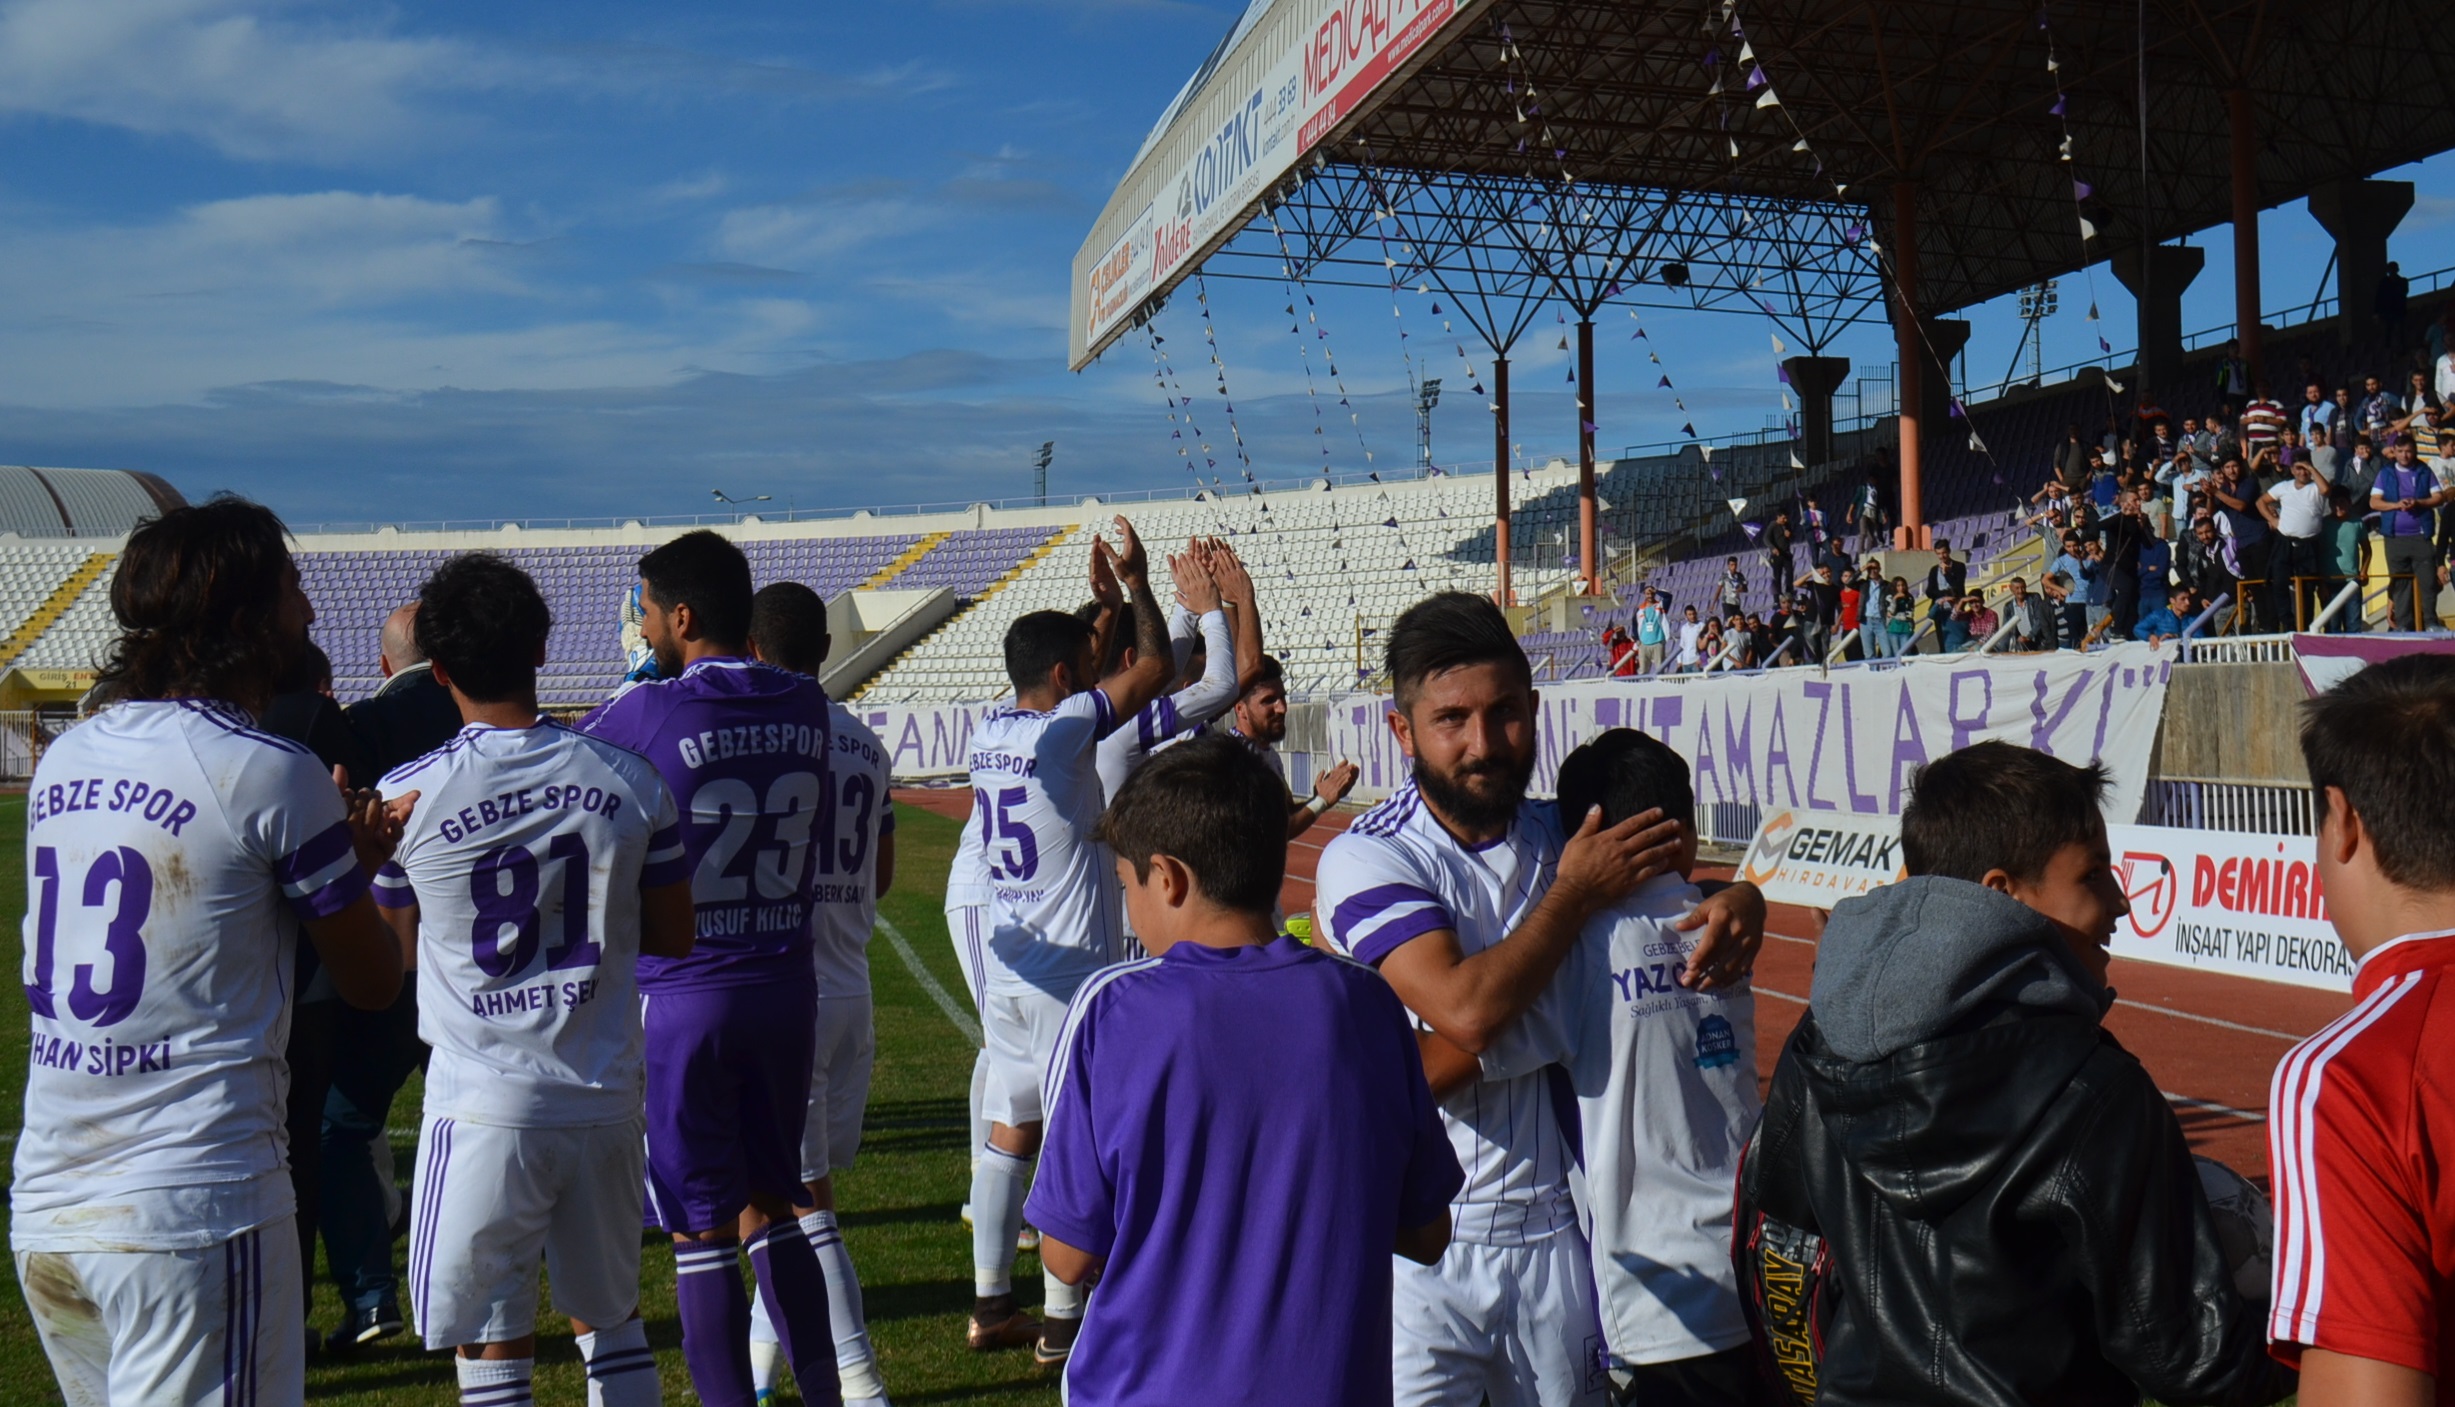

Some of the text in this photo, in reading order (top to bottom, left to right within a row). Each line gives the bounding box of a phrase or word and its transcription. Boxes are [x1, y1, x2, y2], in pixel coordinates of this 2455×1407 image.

[1302, 0, 1419, 109] MEDICAL
[1263, 74, 1297, 128] 444 33 69
[39, 671, 96, 682] GİRİŞ ENT
[65, 680, 77, 689] 21
[678, 723, 824, 770] GEBZESPOR
[838, 735, 880, 770] SPOR
[994, 753, 1038, 779] SPOR
[108, 779, 198, 838] SPOR
[440, 784, 622, 844] GEBZE SPOR
[691, 771, 821, 905] 23
[1788, 827, 1902, 872] GEMAK
[470, 831, 601, 979] 81
[24, 845, 153, 1028] 13
[1642, 942, 1678, 958] GEBZE
[2175, 916, 2353, 977] İNŞAAT YAPI DEKORA
[472, 984, 556, 1018] AHMET
[1611, 962, 1673, 1003] YAZ
[1700, 1029, 1731, 1043] ADNAN
